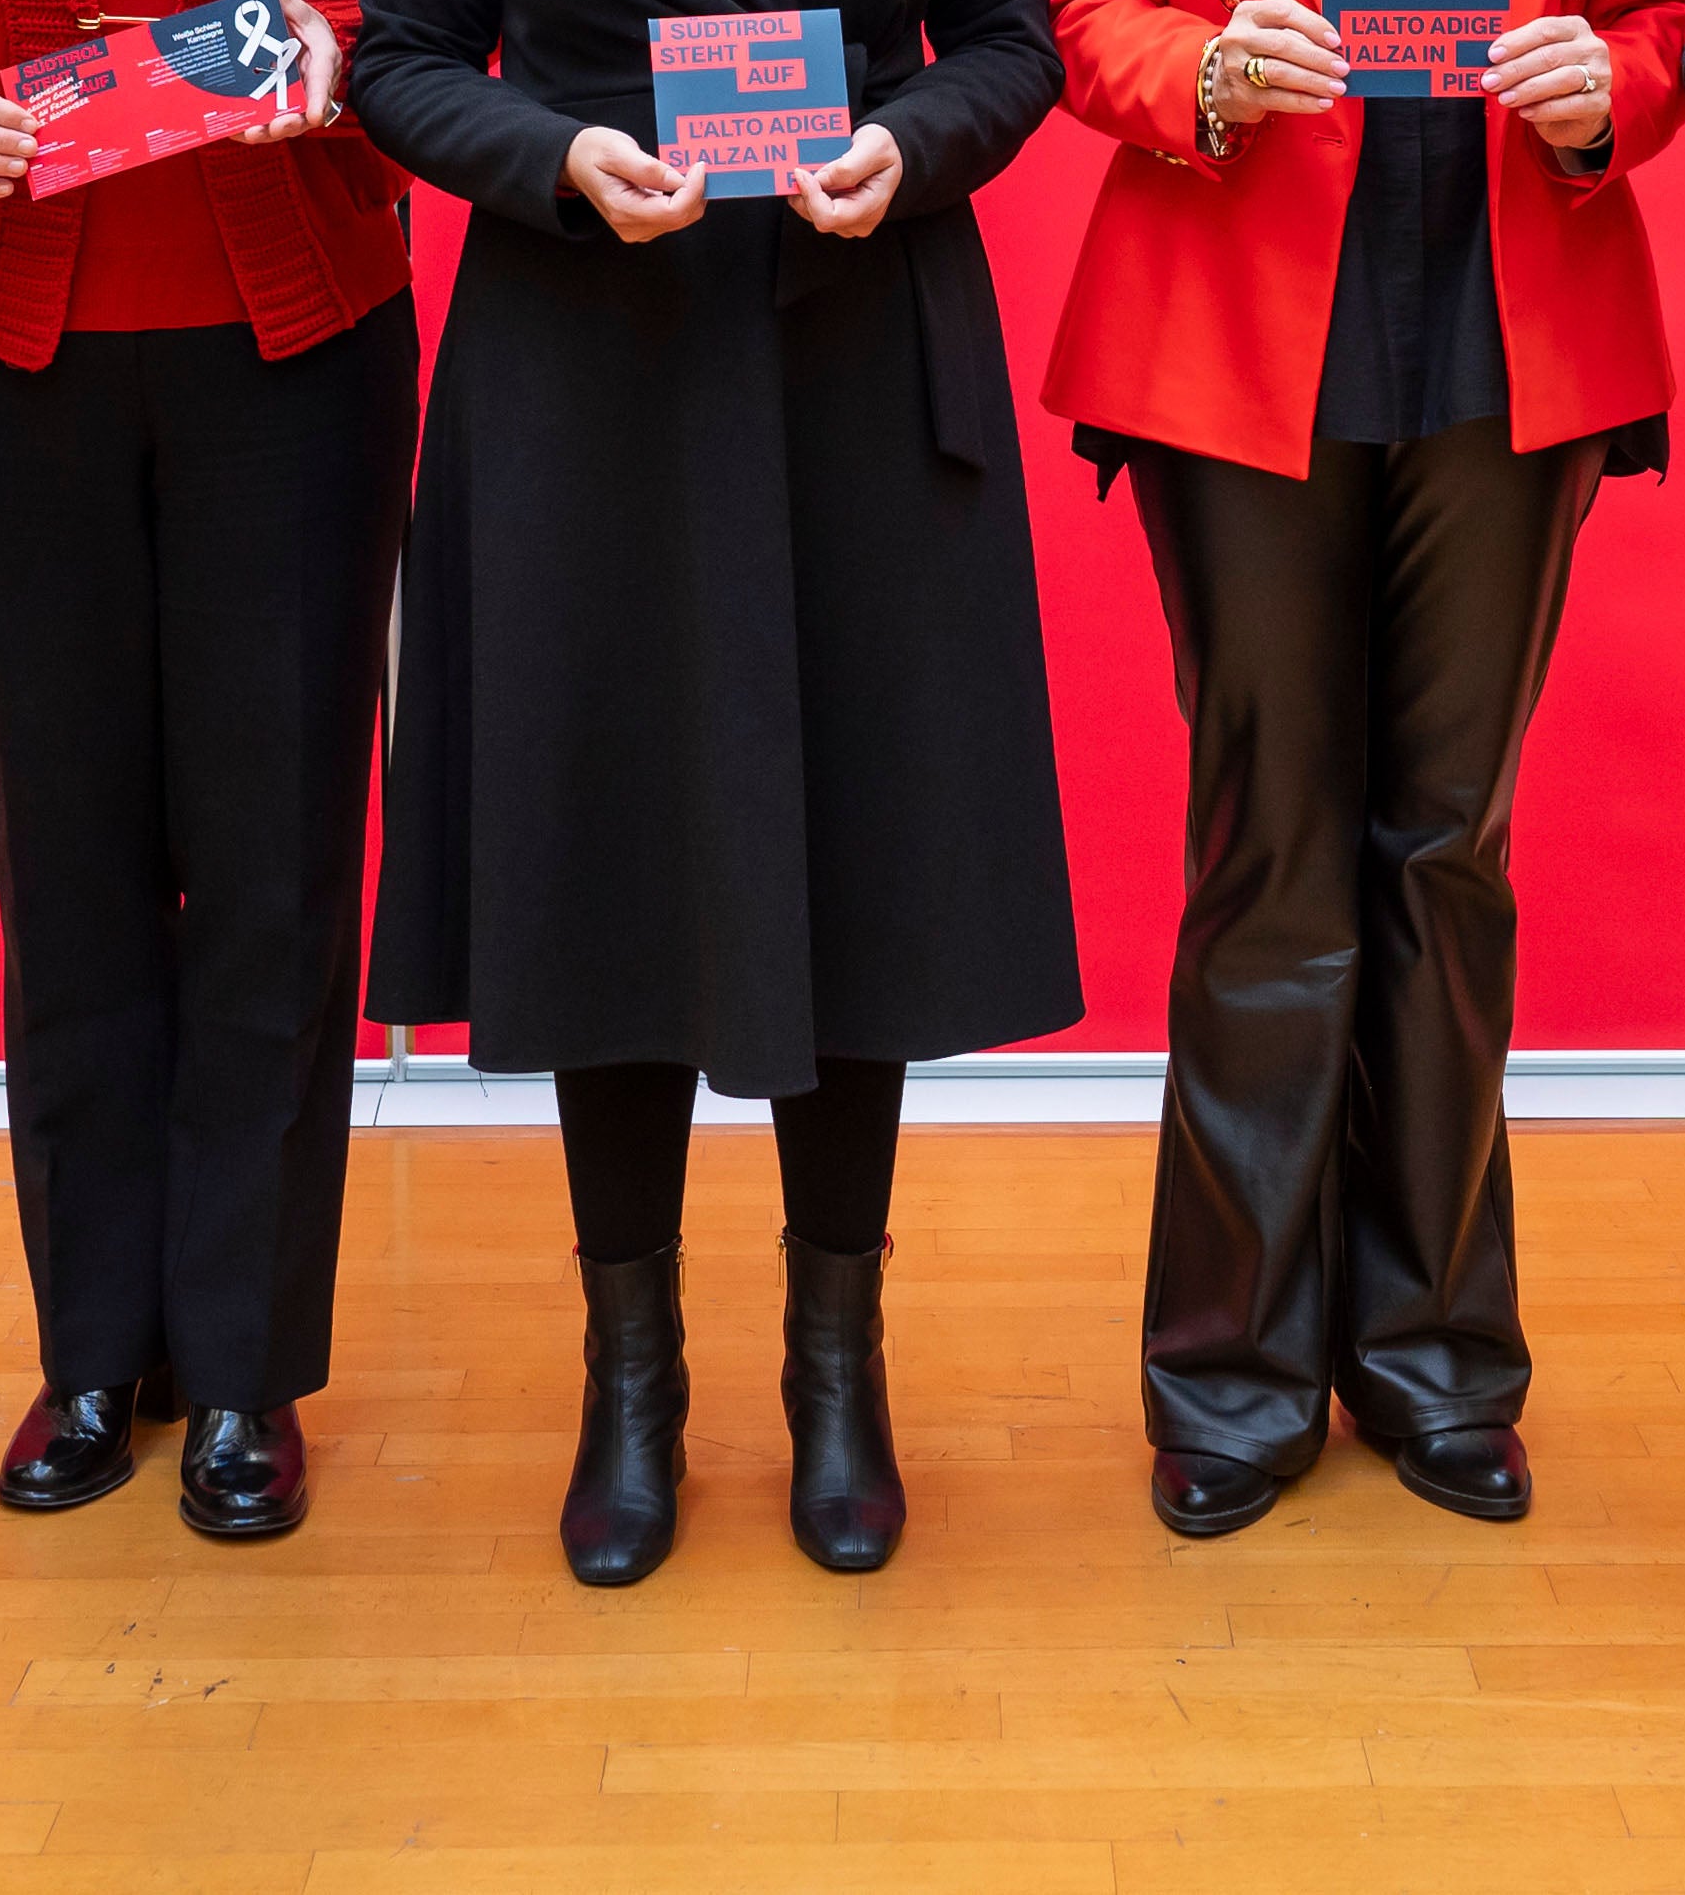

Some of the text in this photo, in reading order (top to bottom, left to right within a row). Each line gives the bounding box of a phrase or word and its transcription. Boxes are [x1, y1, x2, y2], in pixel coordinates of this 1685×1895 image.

[670, 17, 793, 40] SÜDTIROL
[1351, 16, 1502, 35] L'ALTO ADIGE
[660, 44, 738, 66] STEHT
[1355, 45, 1417, 63] ALZA
[1422, 45, 1445, 63] IN
[746, 65, 795, 85] AUF
[688, 113, 844, 139] L'ALTO ADIGE
[668, 144, 788, 168] SI ALZA IN
